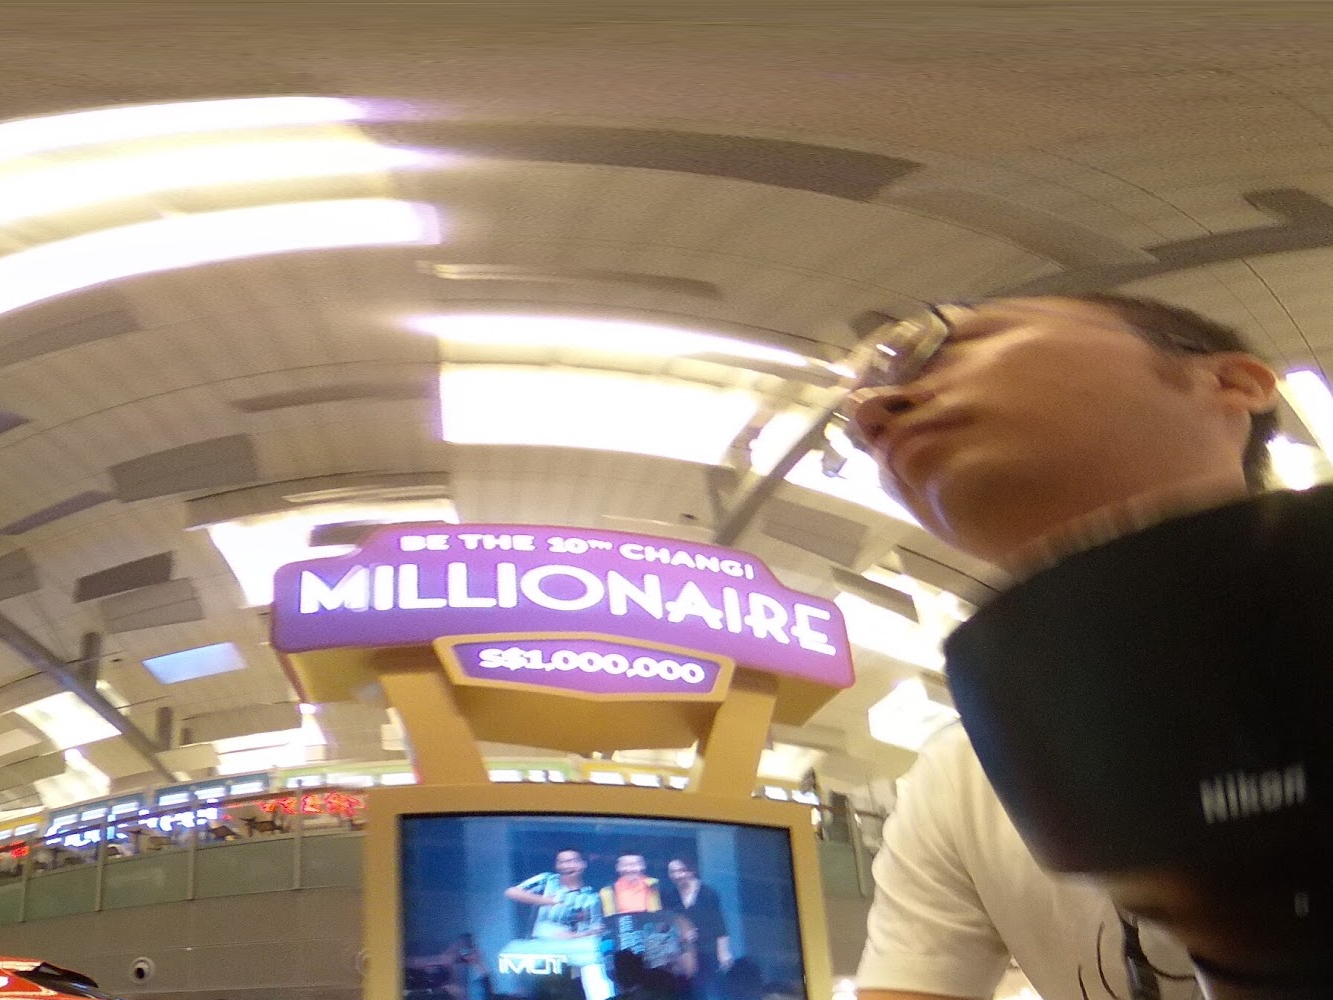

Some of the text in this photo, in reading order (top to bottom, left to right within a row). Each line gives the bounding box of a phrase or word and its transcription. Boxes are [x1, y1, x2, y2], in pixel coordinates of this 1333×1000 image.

[399, 535, 451, 551] BE
[457, 534, 536, 550] THE
[619, 543, 755, 580] CHANGI
[299, 561, 837, 656] MILLIONAIRE
[478, 646, 706, 684] S$1,000,000
[1200, 761, 1307, 824] Nikon
